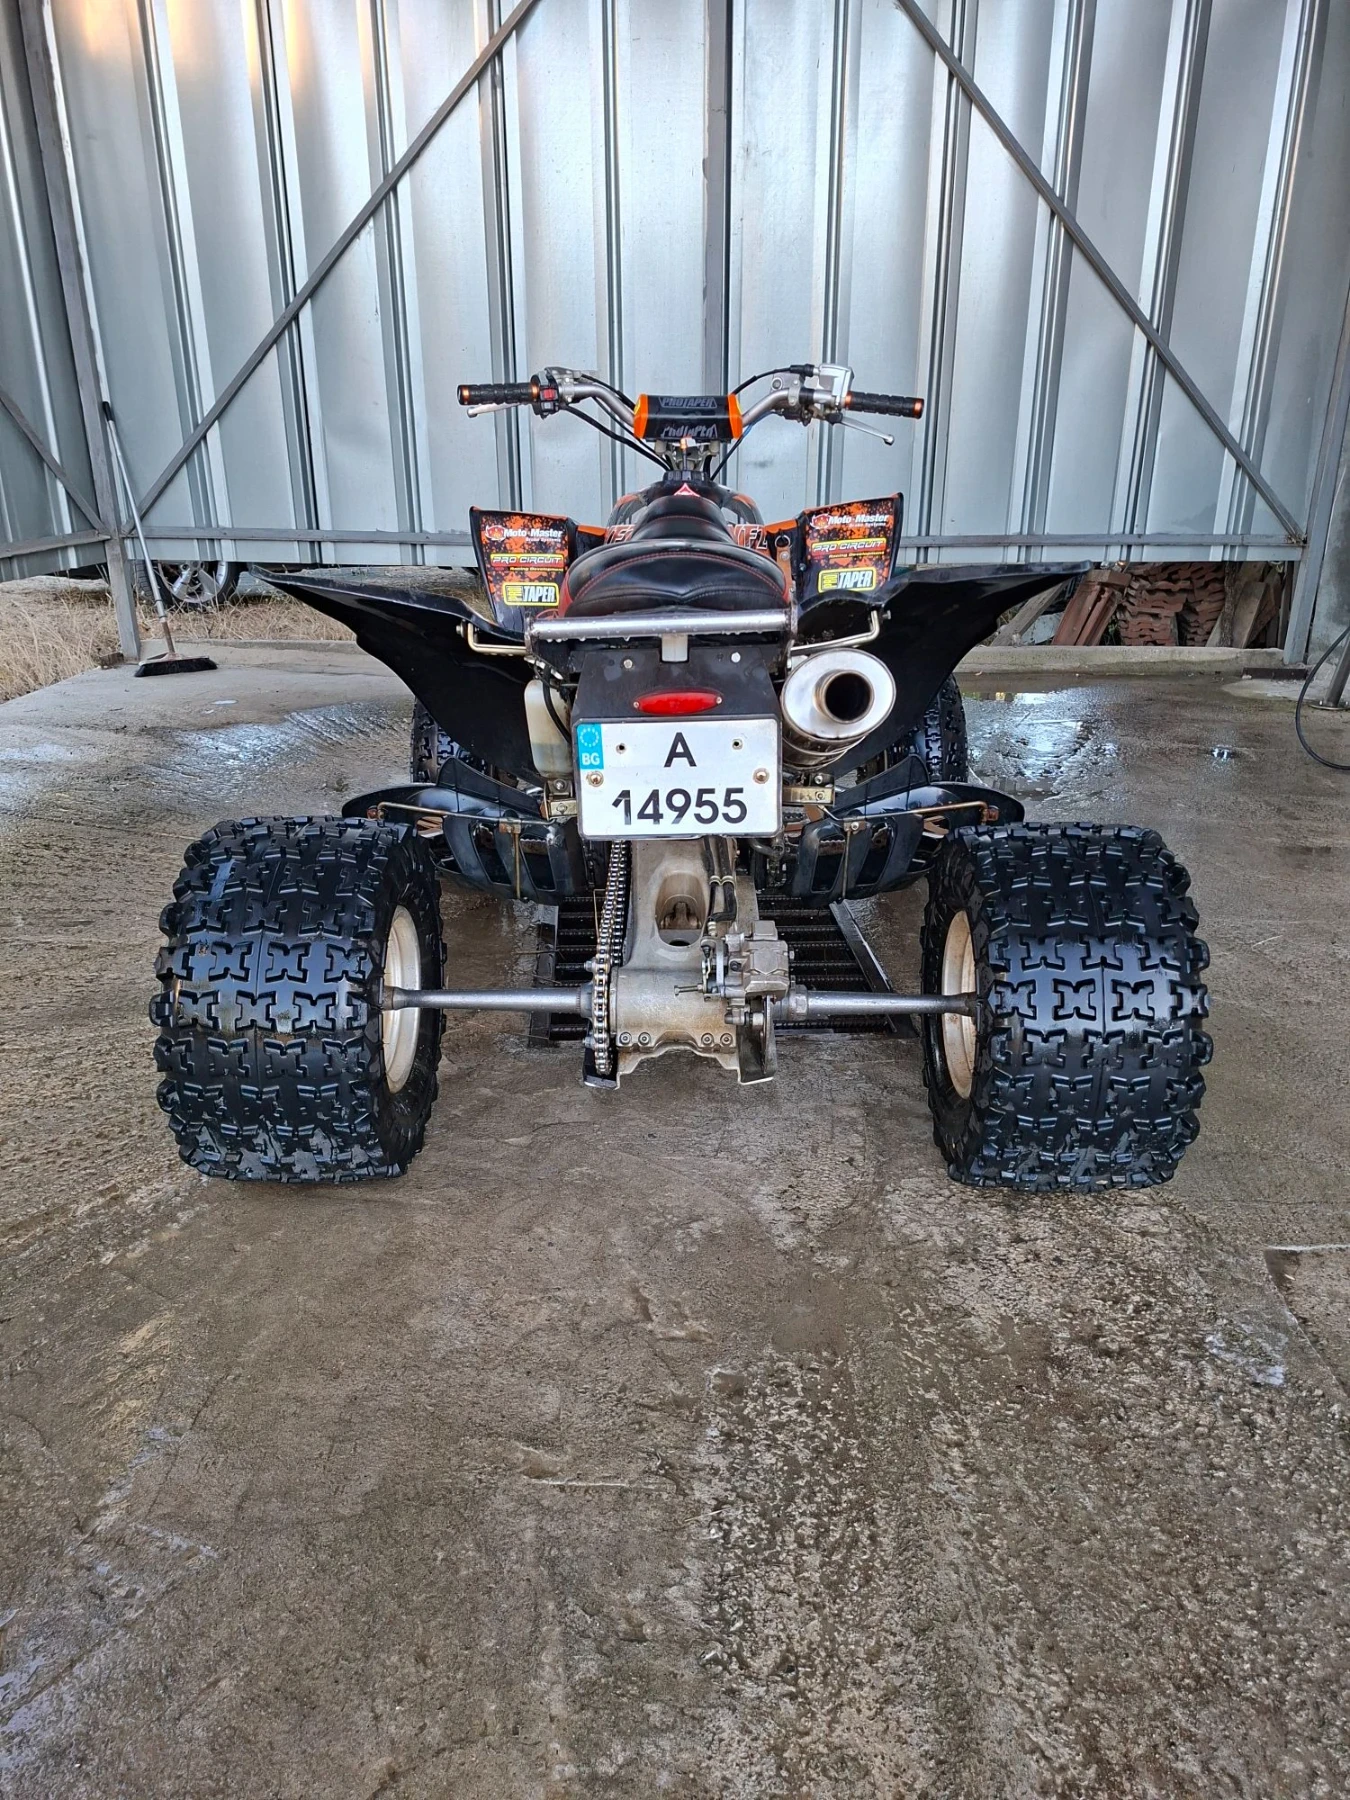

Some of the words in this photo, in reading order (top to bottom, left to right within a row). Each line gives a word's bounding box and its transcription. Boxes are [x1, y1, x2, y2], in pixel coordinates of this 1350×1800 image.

[661, 397, 715, 408] PROTAPER
[813, 543, 837, 553] PRO
[839, 540, 883, 550] CIRCUIT
[492, 556, 517, 564] PRO
[519, 556, 563, 565] CIRCUIT
[838, 570, 873, 589] TAPER
[523, 586, 556, 602] TAPER
[663, 732, 697, 767] A
[581, 752, 600, 765] BG
[612, 787, 748, 825] 14955
